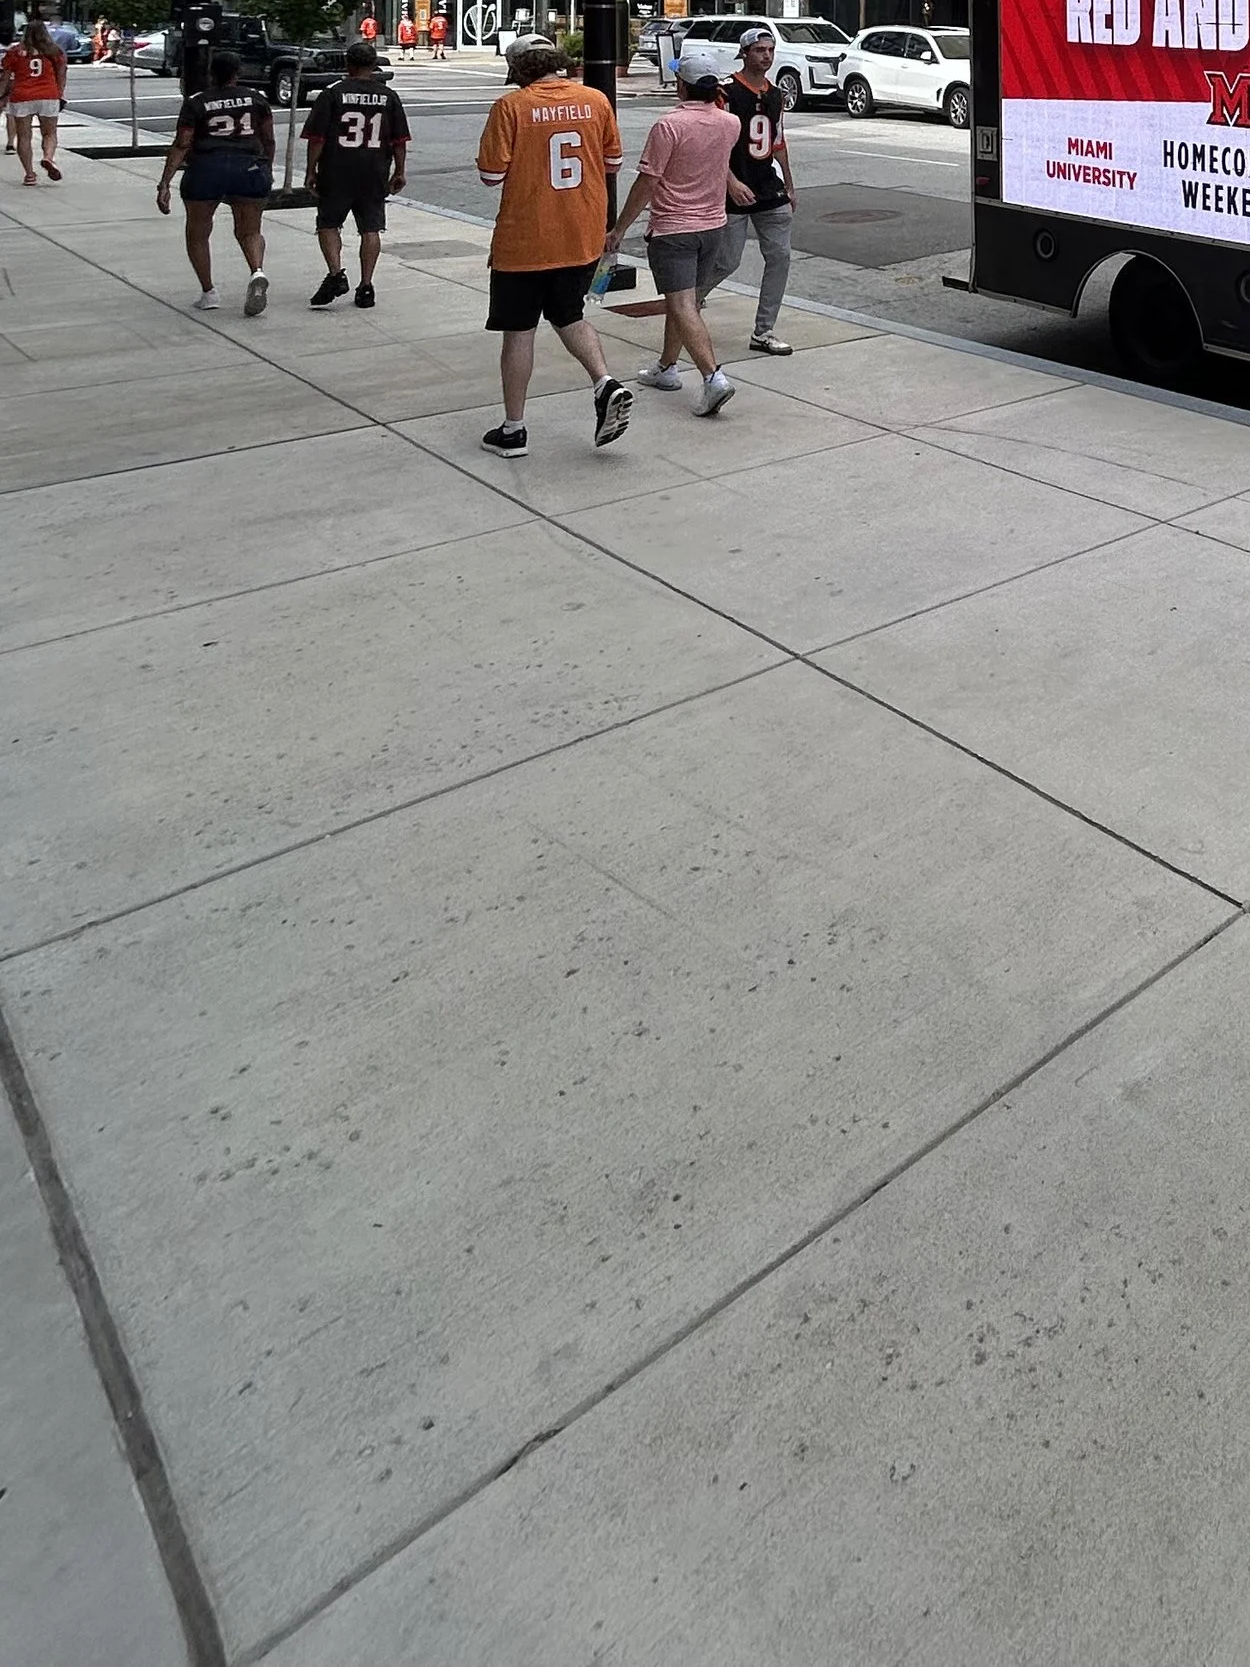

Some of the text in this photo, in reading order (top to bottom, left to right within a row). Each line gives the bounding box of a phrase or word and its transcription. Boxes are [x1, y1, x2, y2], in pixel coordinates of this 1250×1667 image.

[29, 58, 42, 77] 9
[532, 104, 592, 122] MAYFIELD
[338, 111, 383, 149] 31
[748, 114, 772, 160] 9
[548, 130, 583, 191] 6
[1067, 136, 1113, 161] MIAMI
[1046, 160, 1137, 190] UNIVERSITY
